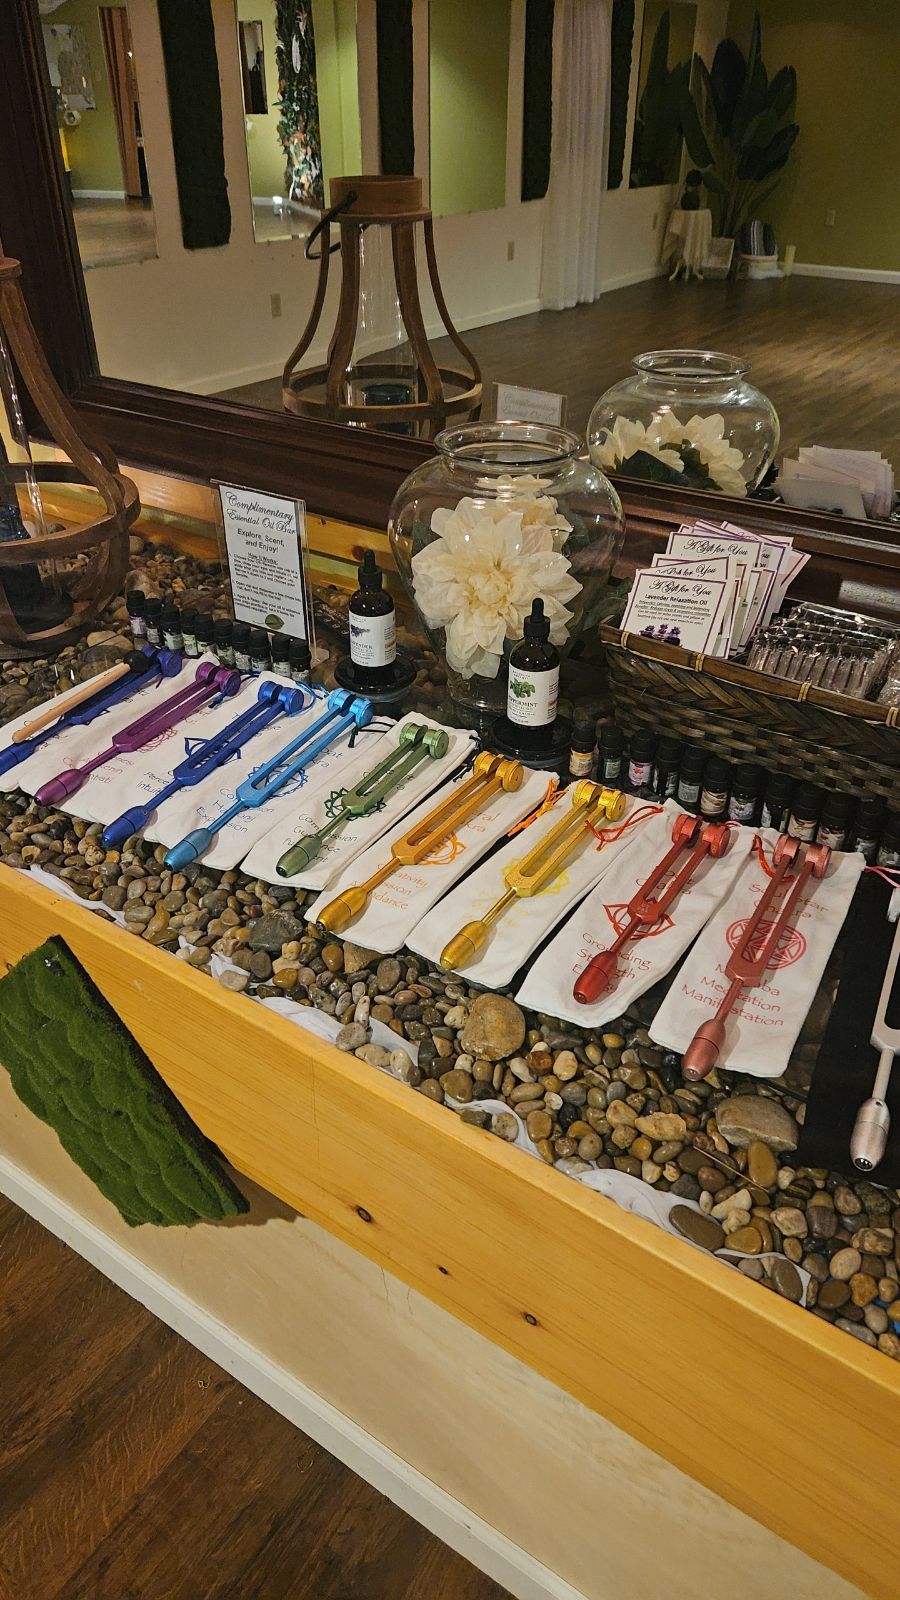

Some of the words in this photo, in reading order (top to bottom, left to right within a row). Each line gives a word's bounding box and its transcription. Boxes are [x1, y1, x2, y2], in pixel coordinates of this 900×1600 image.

[225, 491, 294, 527] Complimentary
[226, 508, 260, 525] Essential
[262, 517, 275, 529] Oil
[276, 520, 296, 534] Bar
[237, 527, 264, 542] Explore,
[265, 535, 285, 547] Scent,
[259, 543, 279, 553] Enjoy!
[696, 540, 712, 554] Gift
[727, 543, 748, 556] You
[695, 563, 717, 578] You
[661, 579, 679, 594] Gift
[692, 584, 712, 597] You
[645, 593, 669, 602] Lavender
[669, 596, 699, 605] Relaxation
[681, 984, 785, 1026] Manifstation
